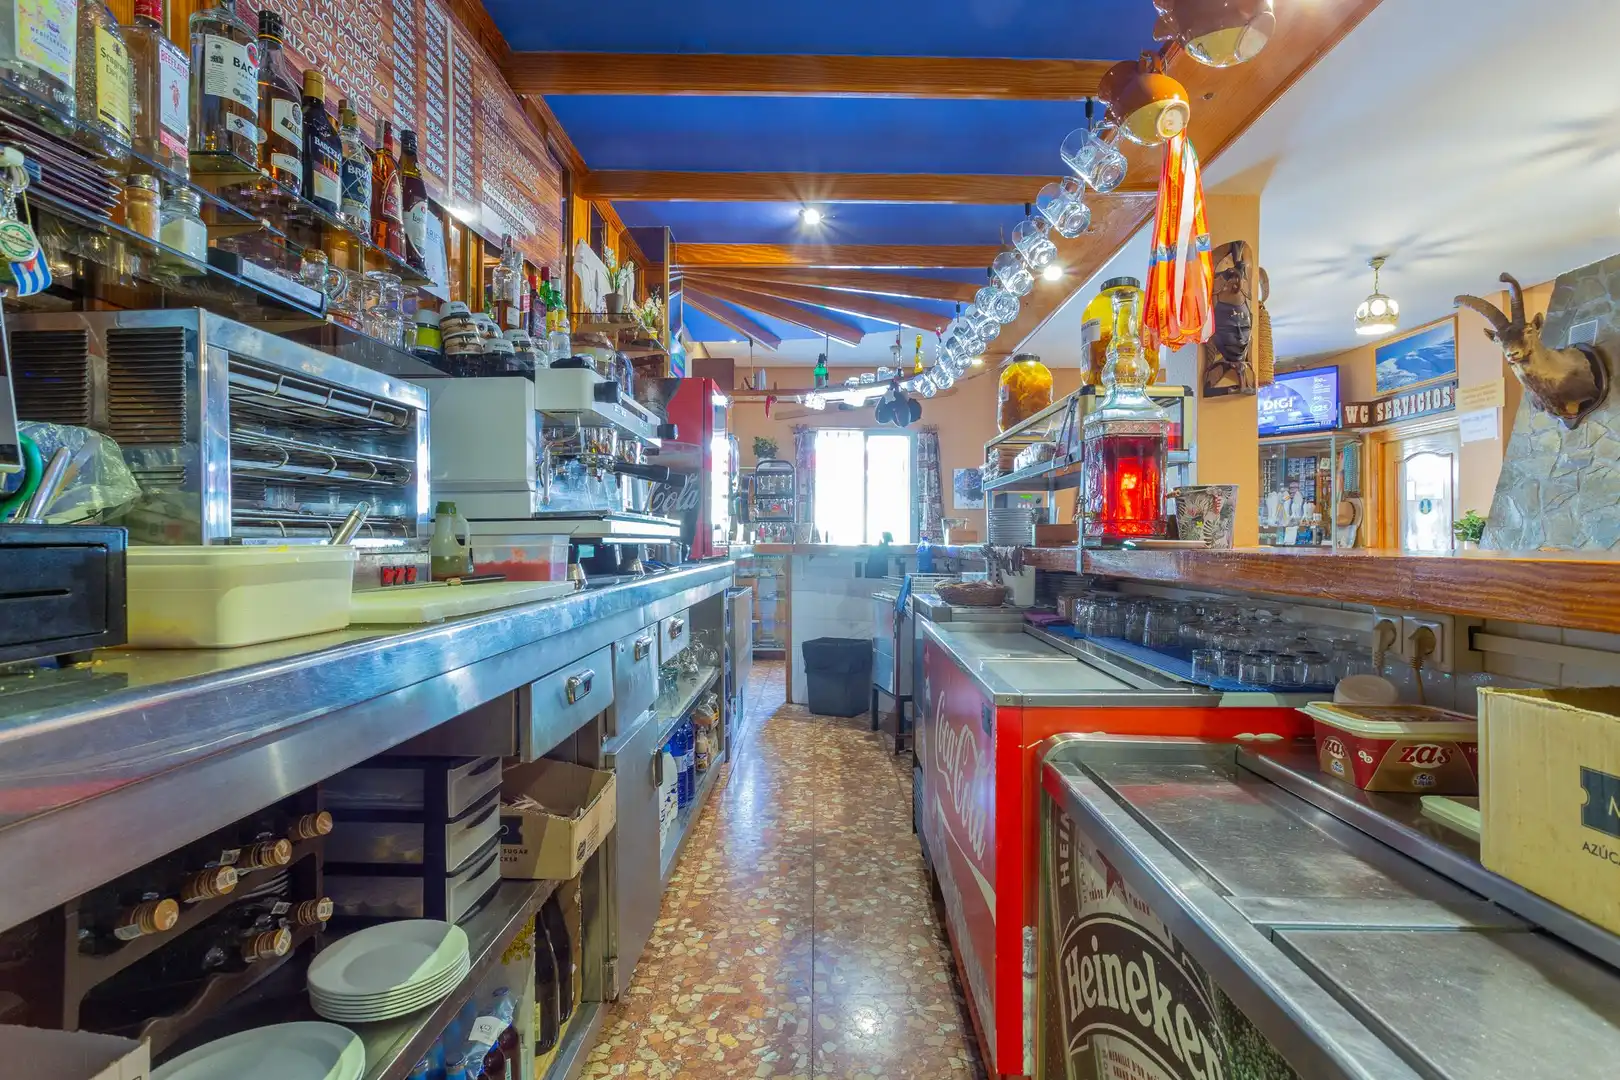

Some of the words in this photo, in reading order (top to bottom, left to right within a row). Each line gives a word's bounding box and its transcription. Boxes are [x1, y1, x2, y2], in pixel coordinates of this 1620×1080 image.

[302, 10, 332, 44] CON
[336, 43, 389, 99] CHORIZO
[307, 32, 338, 67] CON
[340, 66, 373, 99] AJOS
[337, 26, 377, 73] POBRE
[1263, 396, 1293, 411] DIGI
[1345, 405, 1370, 424] WC
[1376, 386, 1455, 422] SERVICIOS
[1324, 739, 1346, 759] zas
[1396, 746, 1452, 764] zas
[1582, 841, 1620, 867] AZÚC
[1065, 934, 1225, 1080] Heineken
